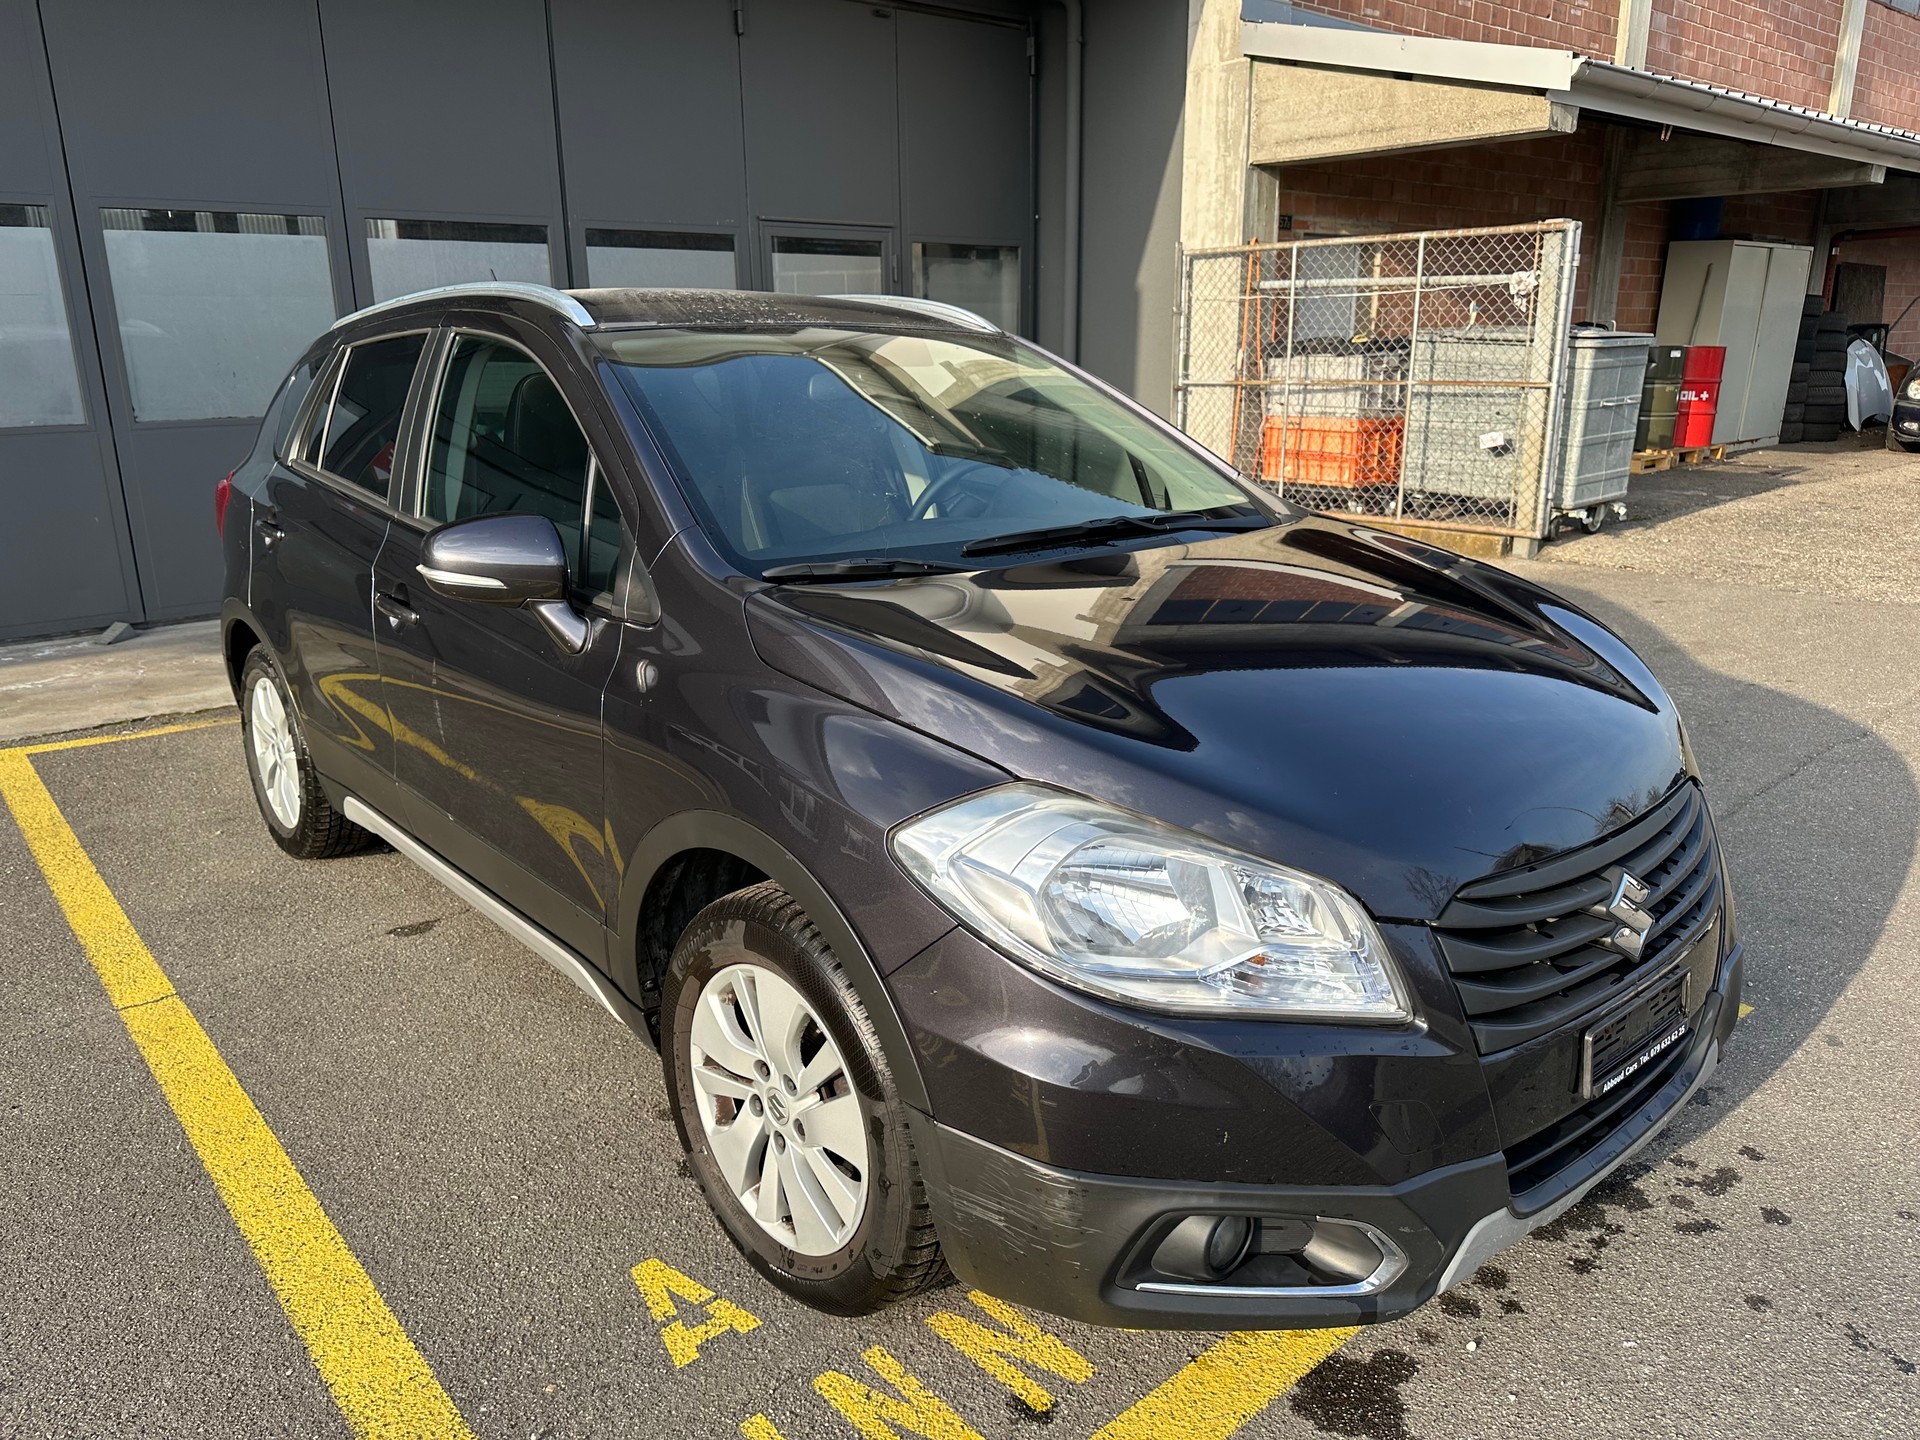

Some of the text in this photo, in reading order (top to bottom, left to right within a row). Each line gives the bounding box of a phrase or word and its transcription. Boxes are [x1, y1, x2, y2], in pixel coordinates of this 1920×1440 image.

[1680, 391, 1699, 401] OIL
[1603, 1025, 1686, 1093] Abboud Cars Tel. 079 632 62 25
